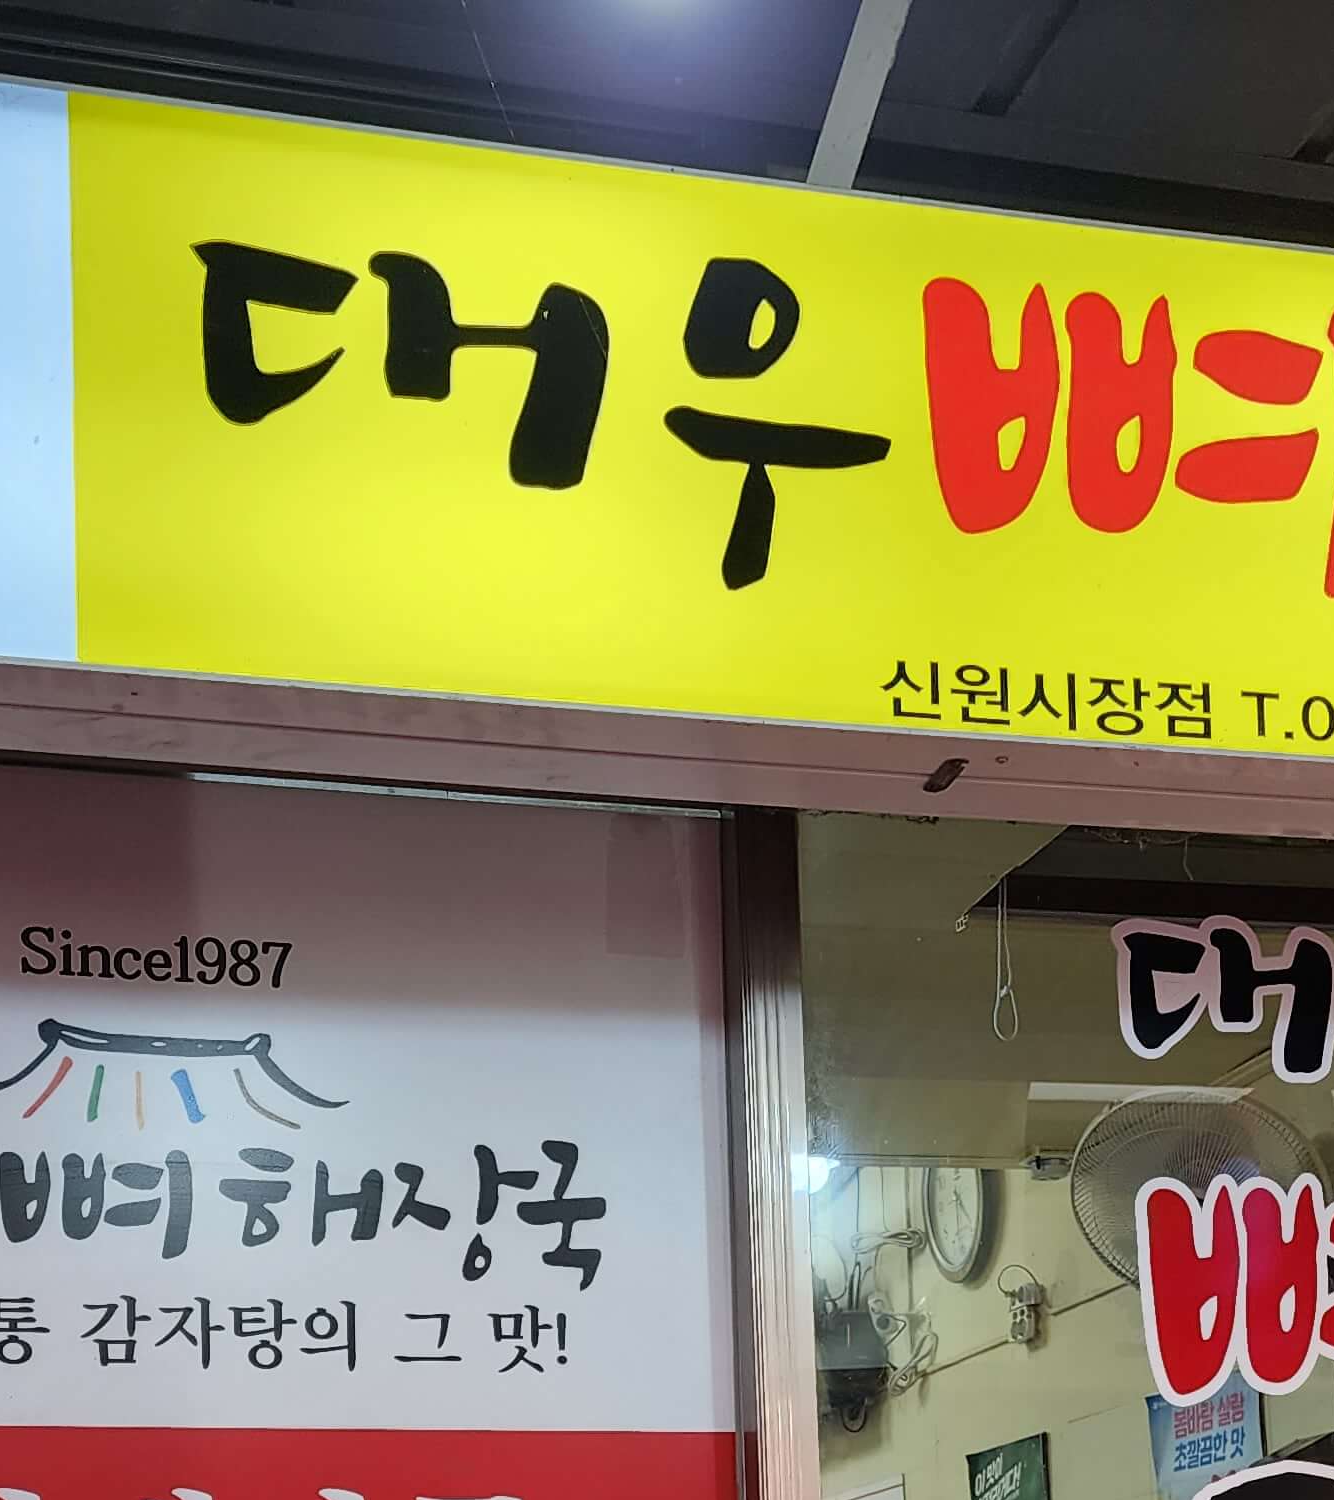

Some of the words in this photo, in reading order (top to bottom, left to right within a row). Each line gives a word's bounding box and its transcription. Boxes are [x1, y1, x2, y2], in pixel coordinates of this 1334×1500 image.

[190, 239, 891, 590] 대우
[879, 658, 1213, 739] 신원시장점
[19, 924, 293, 990] Since1987
[219, 1140, 609, 1290] 해장국
[79, 1295, 358, 1374] 감자탕의
[395, 1310, 463, 1367] 그
[494, 1304, 569, 1375] 맛!
[1230, 1426, 1245, 1458] 맛
